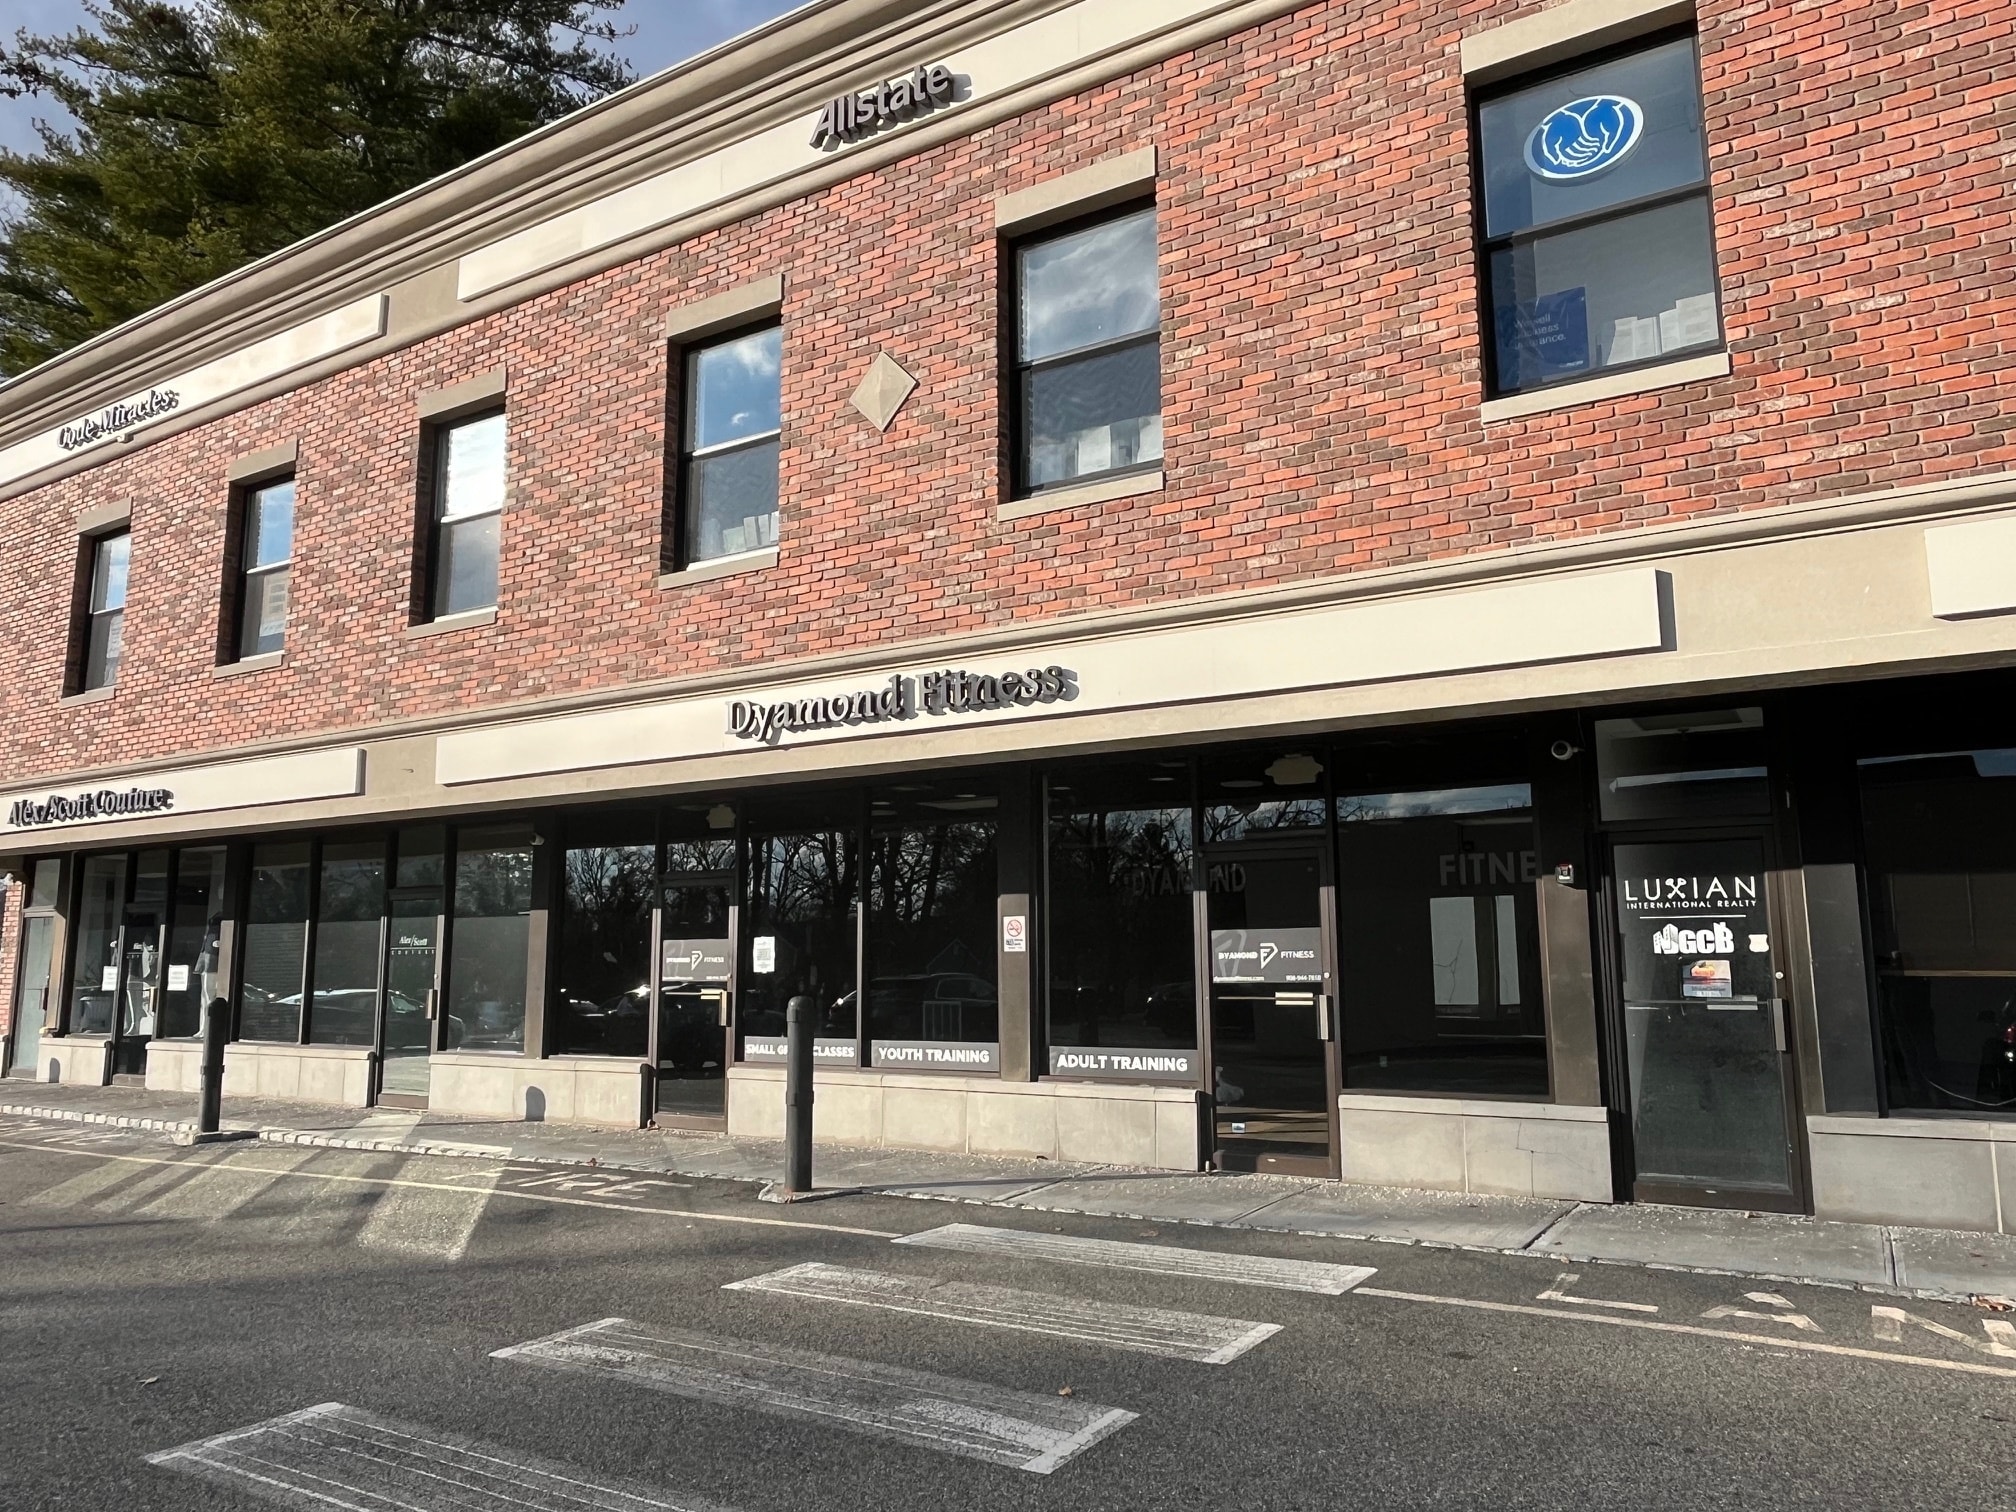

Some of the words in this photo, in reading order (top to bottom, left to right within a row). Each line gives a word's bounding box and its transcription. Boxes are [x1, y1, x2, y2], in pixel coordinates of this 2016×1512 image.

[809, 64, 955, 151] Allstate
[101, 389, 178, 431] Miracles
[725, 674, 904, 741] Dyamond
[915, 665, 1075, 713] Fitness
[93, 789, 167, 816] Couture
[1624, 875, 1757, 901] LUXIAN
[1626, 900, 1712, 910] INTERNATIONAL
[1717, 900, 1757, 908] REALTY
[1218, 951, 1258, 960] DYAMOND
[1281, 950, 1315, 959] FITNESS
[745, 1044, 776, 1055] SMALL
[813, 1045, 855, 1058] CLASSES
[879, 1047, 923, 1061] YOUTH
[925, 1049, 990, 1063] TRAINING
[1057, 1054, 1108, 1069] ADULT
[1111, 1056, 1188, 1072] TRAINING
